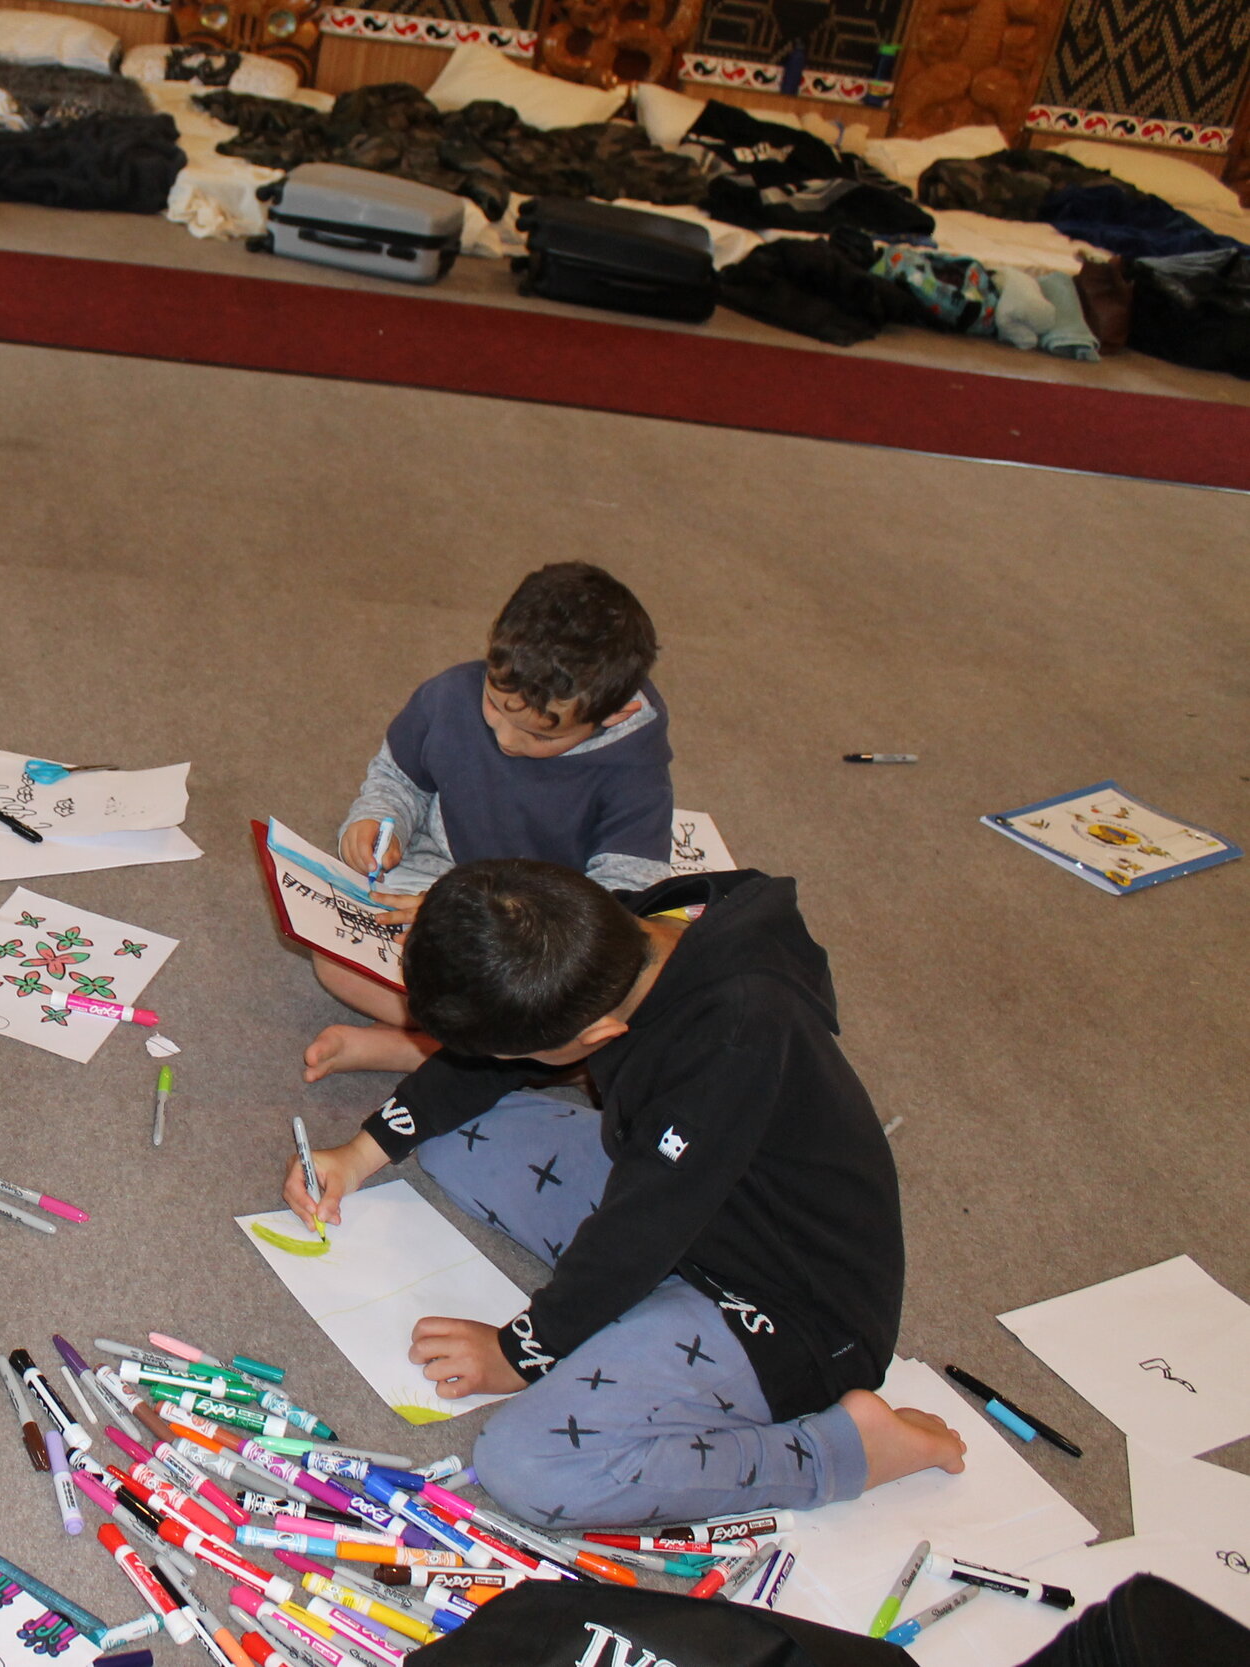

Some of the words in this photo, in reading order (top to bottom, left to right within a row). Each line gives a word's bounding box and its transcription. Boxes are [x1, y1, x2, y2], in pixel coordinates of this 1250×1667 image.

[89, 1004, 123, 1019] EXPO
[195, 1399, 237, 1419] EXPO
[351, 1496, 392, 1523] EXPO
[711, 1523, 749, 1542] EXPO
[433, 1573, 474, 1588] EXPO
